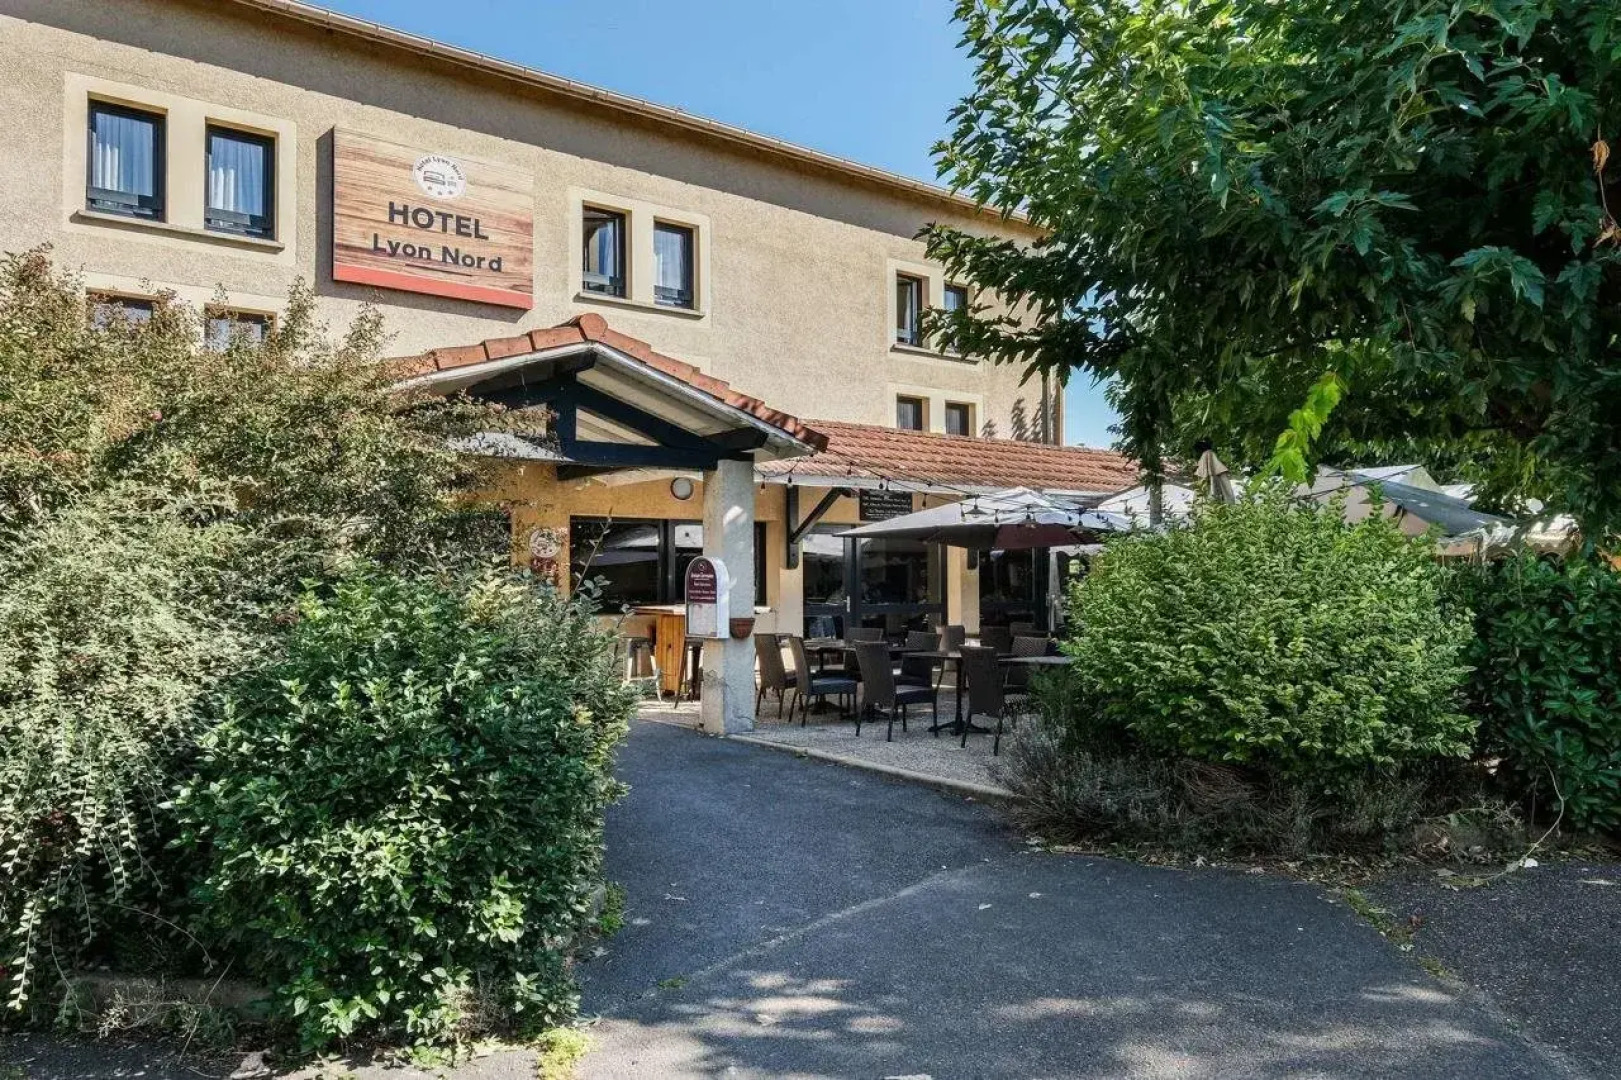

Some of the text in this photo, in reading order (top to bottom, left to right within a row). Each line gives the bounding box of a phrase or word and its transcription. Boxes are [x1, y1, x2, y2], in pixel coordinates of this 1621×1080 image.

[388, 201, 489, 240] HOTEL
[373, 233, 502, 273] Lyon Nord
